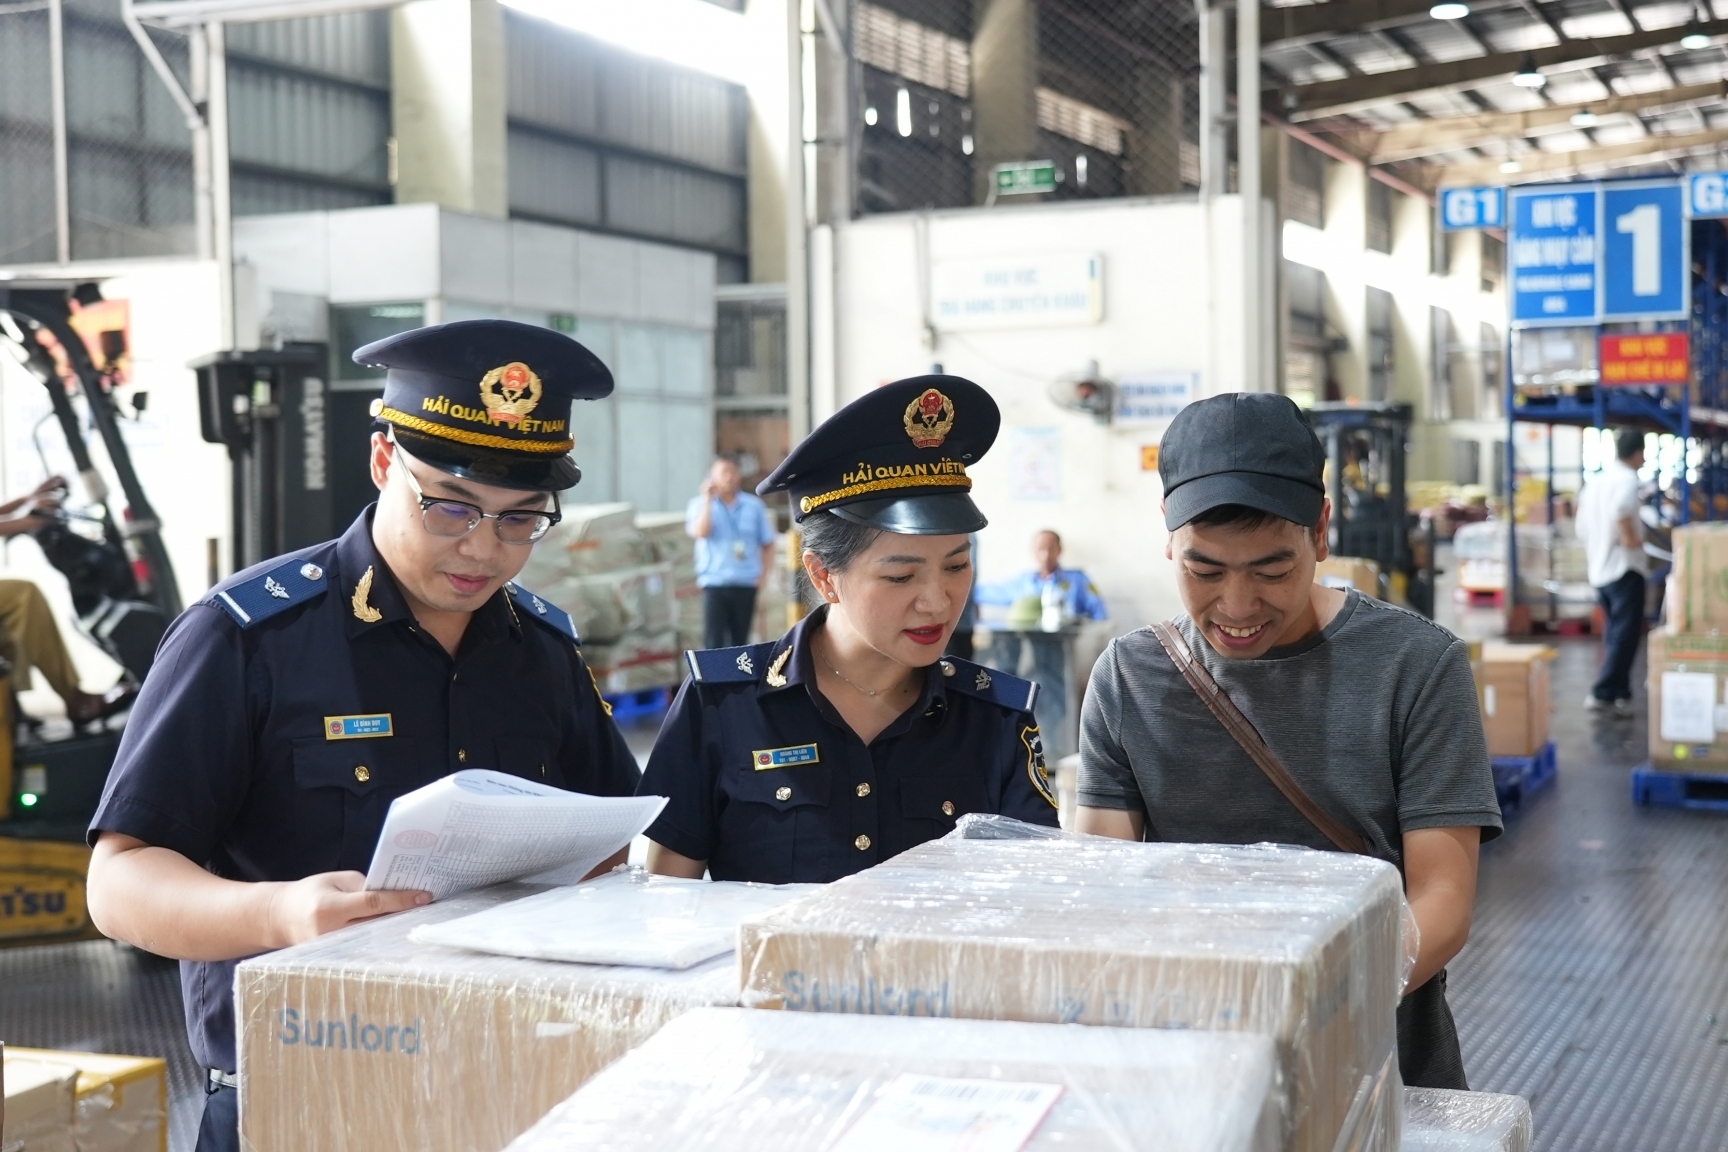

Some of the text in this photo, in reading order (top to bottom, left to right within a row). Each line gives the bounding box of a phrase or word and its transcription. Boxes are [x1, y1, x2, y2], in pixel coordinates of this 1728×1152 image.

[1446, 191, 1498, 225] G1
[1616, 204, 1661, 296] 1
[542, 420, 564, 433] NAM
[875, 463, 928, 479] QUAN
[783, 970, 949, 1018] Sunlord
[278, 1007, 421, 1055] Sunlord
